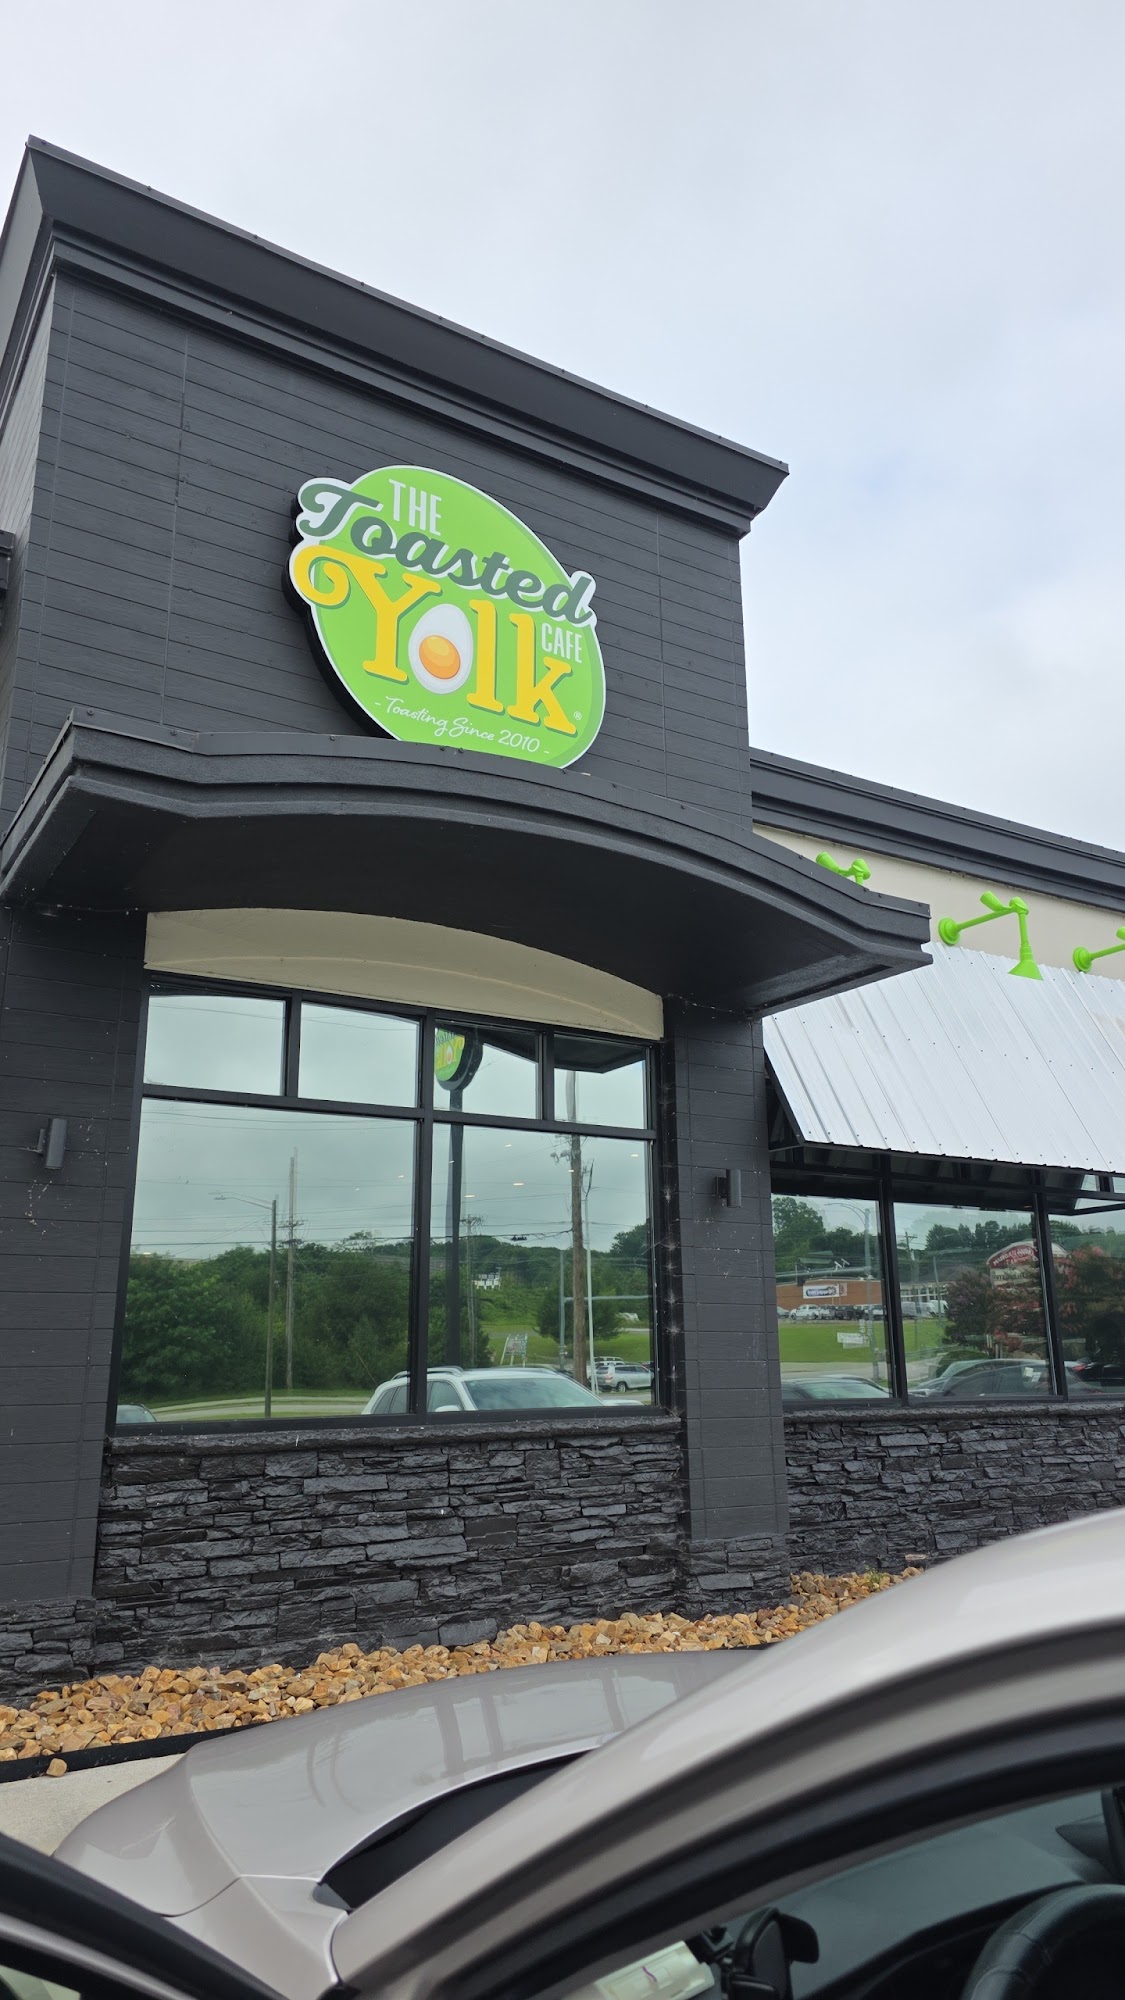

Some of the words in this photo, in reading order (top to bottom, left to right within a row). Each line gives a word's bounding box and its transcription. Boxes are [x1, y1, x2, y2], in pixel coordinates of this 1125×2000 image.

[389, 479, 441, 536] THE
[299, 483, 593, 625] Toasted
[293, 545, 578, 736] Yolk
[541, 622, 583, 664] CAFE
[386, 695, 448, 737] Toasting
[449, 717, 495, 741] Since
[498, 729, 541, 752] 2010
